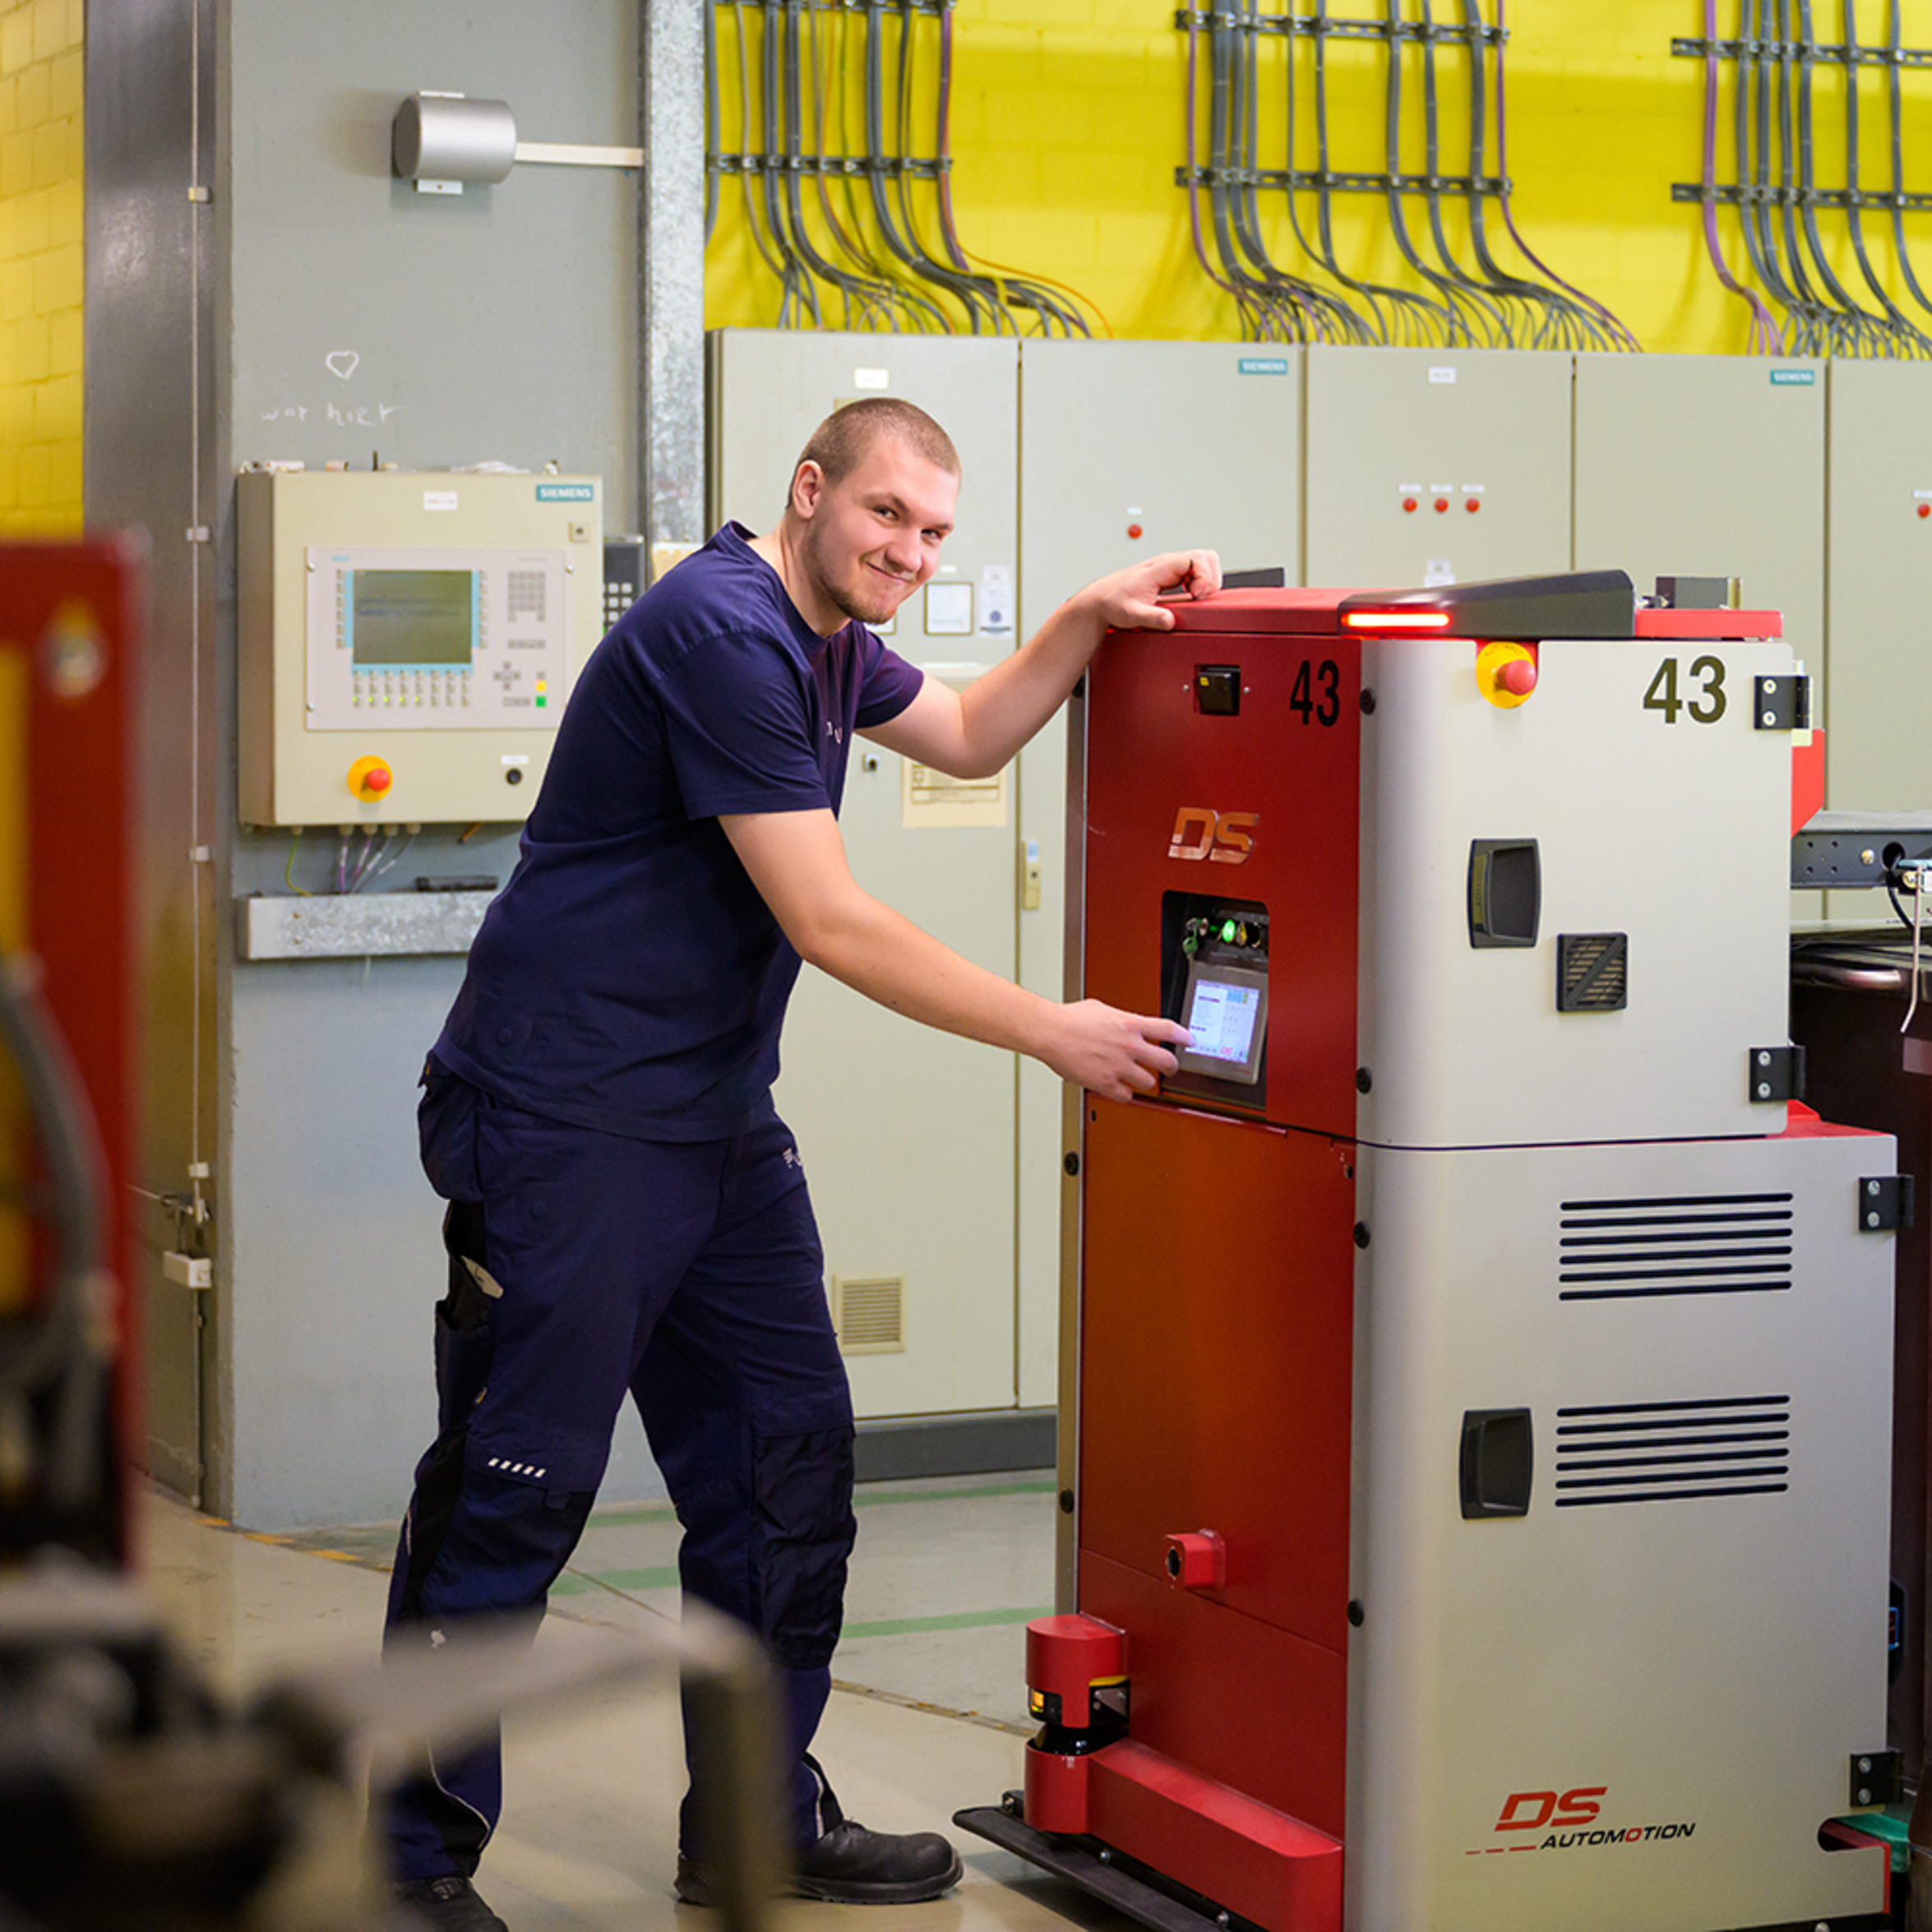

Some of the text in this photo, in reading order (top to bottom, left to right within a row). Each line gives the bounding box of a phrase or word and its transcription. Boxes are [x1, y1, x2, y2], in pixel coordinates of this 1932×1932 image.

[540, 488, 591, 499] SIEMENS
[1290, 659, 1339, 727] 43
[1643, 655, 1726, 723] 43
[1168, 807, 1259, 864] DS
[1494, 1786, 1608, 1832] DS
[1540, 1822, 1696, 1850] AUTOMOTION
